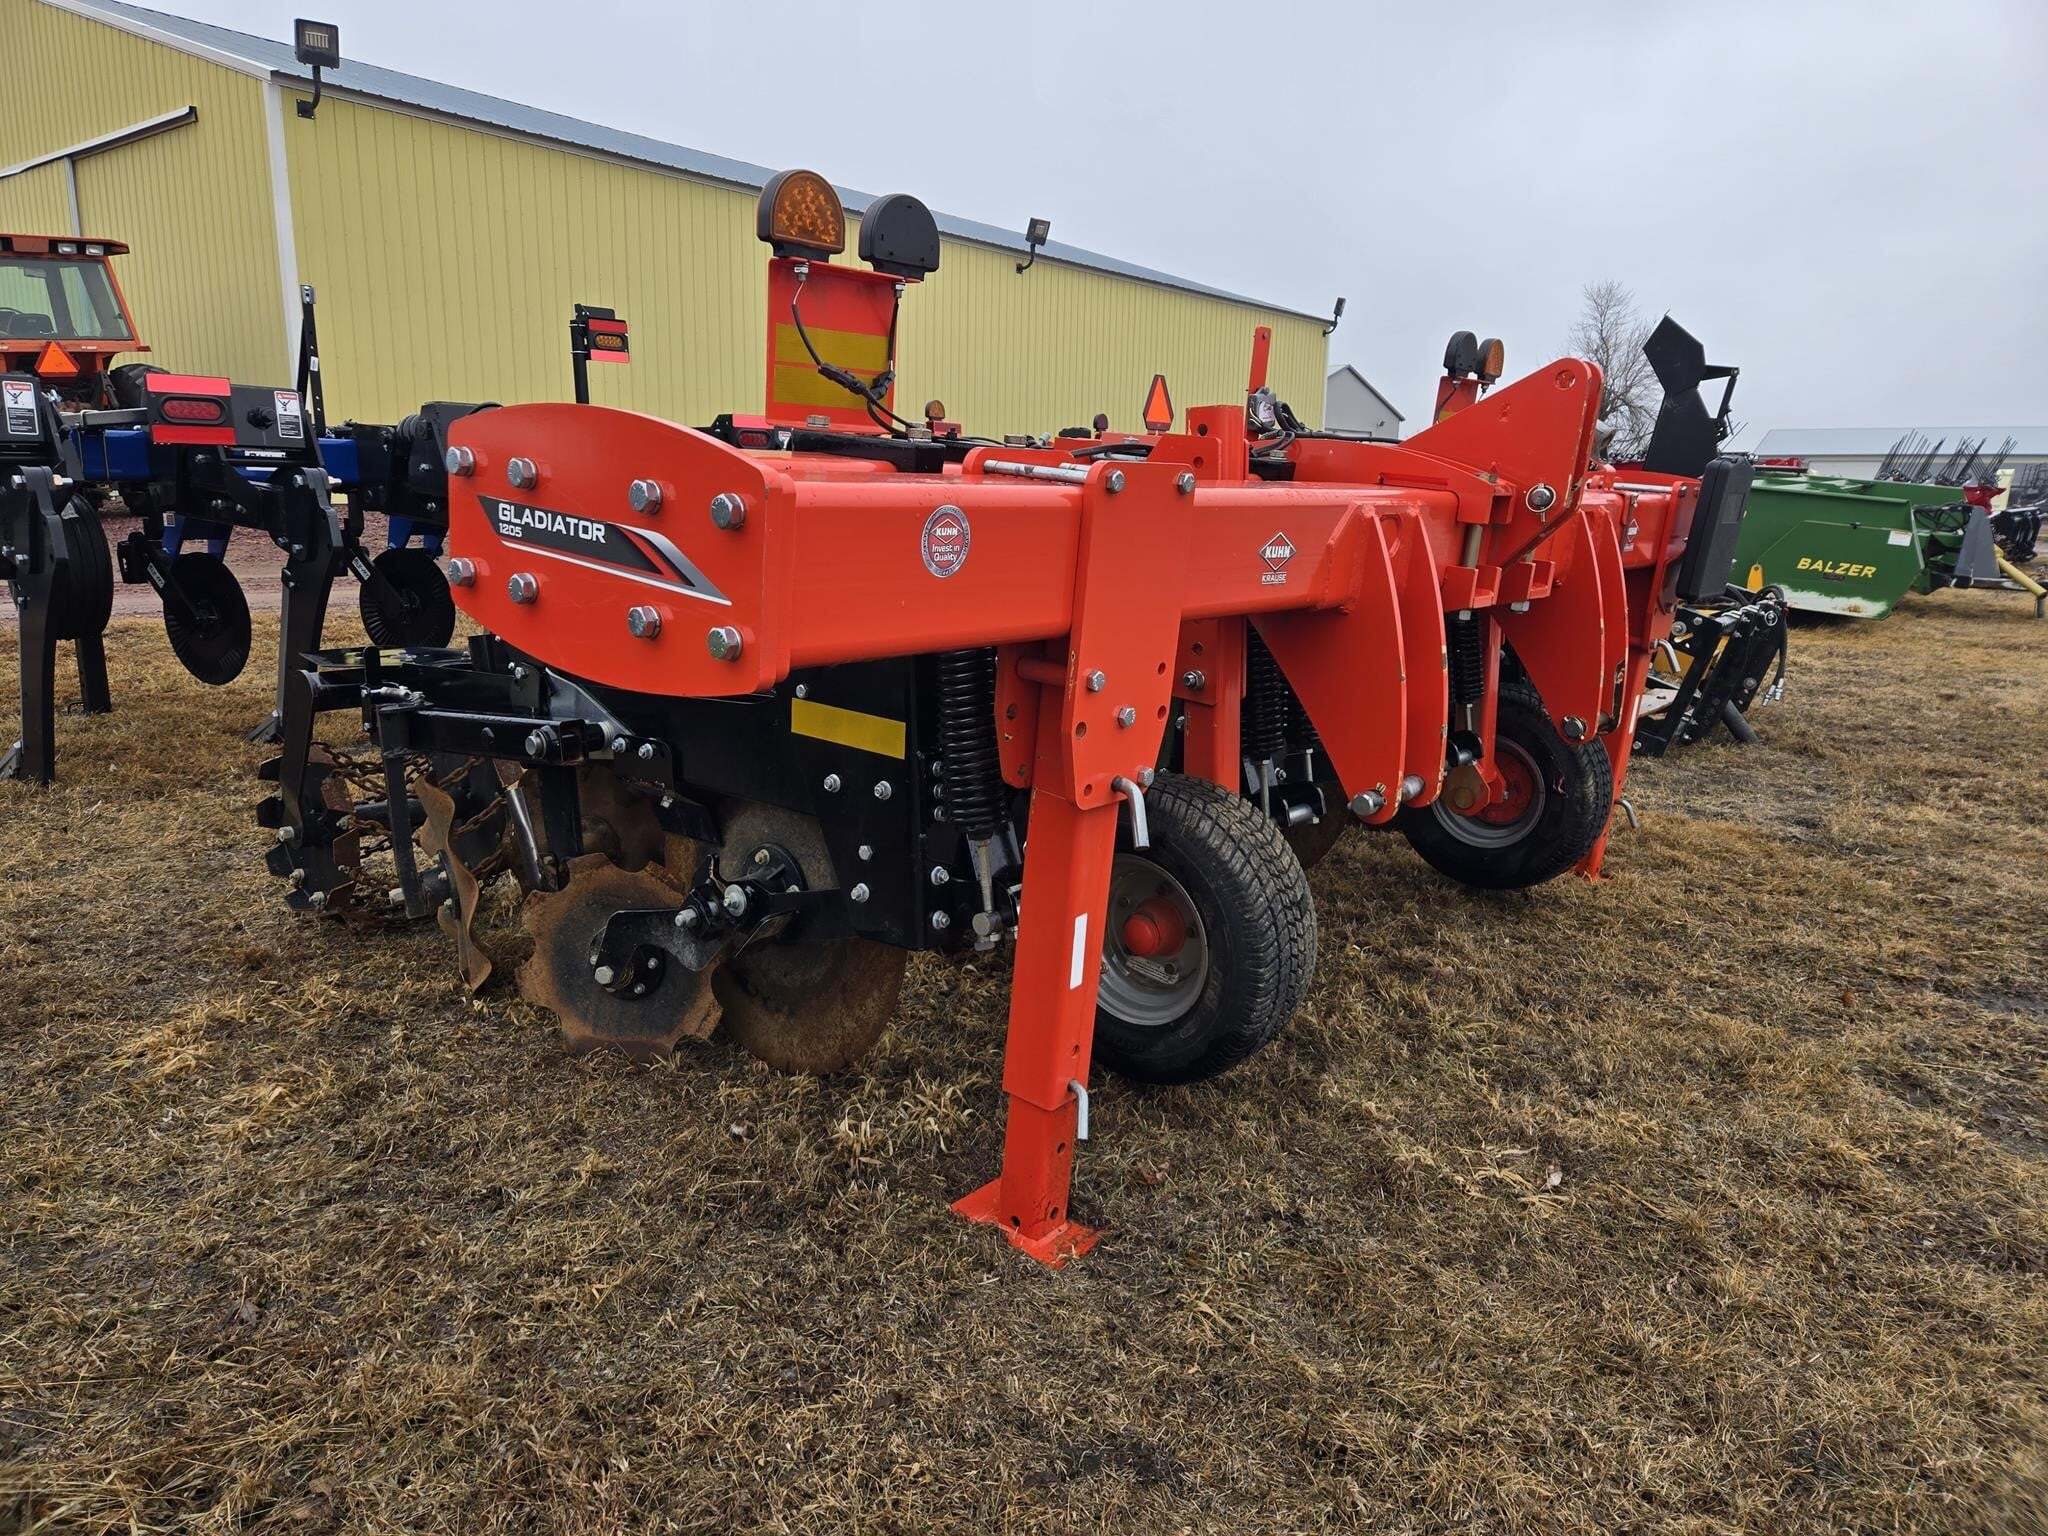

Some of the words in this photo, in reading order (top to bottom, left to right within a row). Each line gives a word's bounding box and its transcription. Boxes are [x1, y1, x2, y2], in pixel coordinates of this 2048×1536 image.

[498, 502, 606, 543] GLADIATOR
[499, 522, 522, 537] 1205
[935, 527, 958, 536] KUHN
[932, 544, 952, 552] Invest
[1265, 545, 1291, 559] KUHN
[933, 552, 957, 562] Quality
[1797, 557, 1877, 578] BALZER
[1262, 574, 1287, 583] KRAUSE
